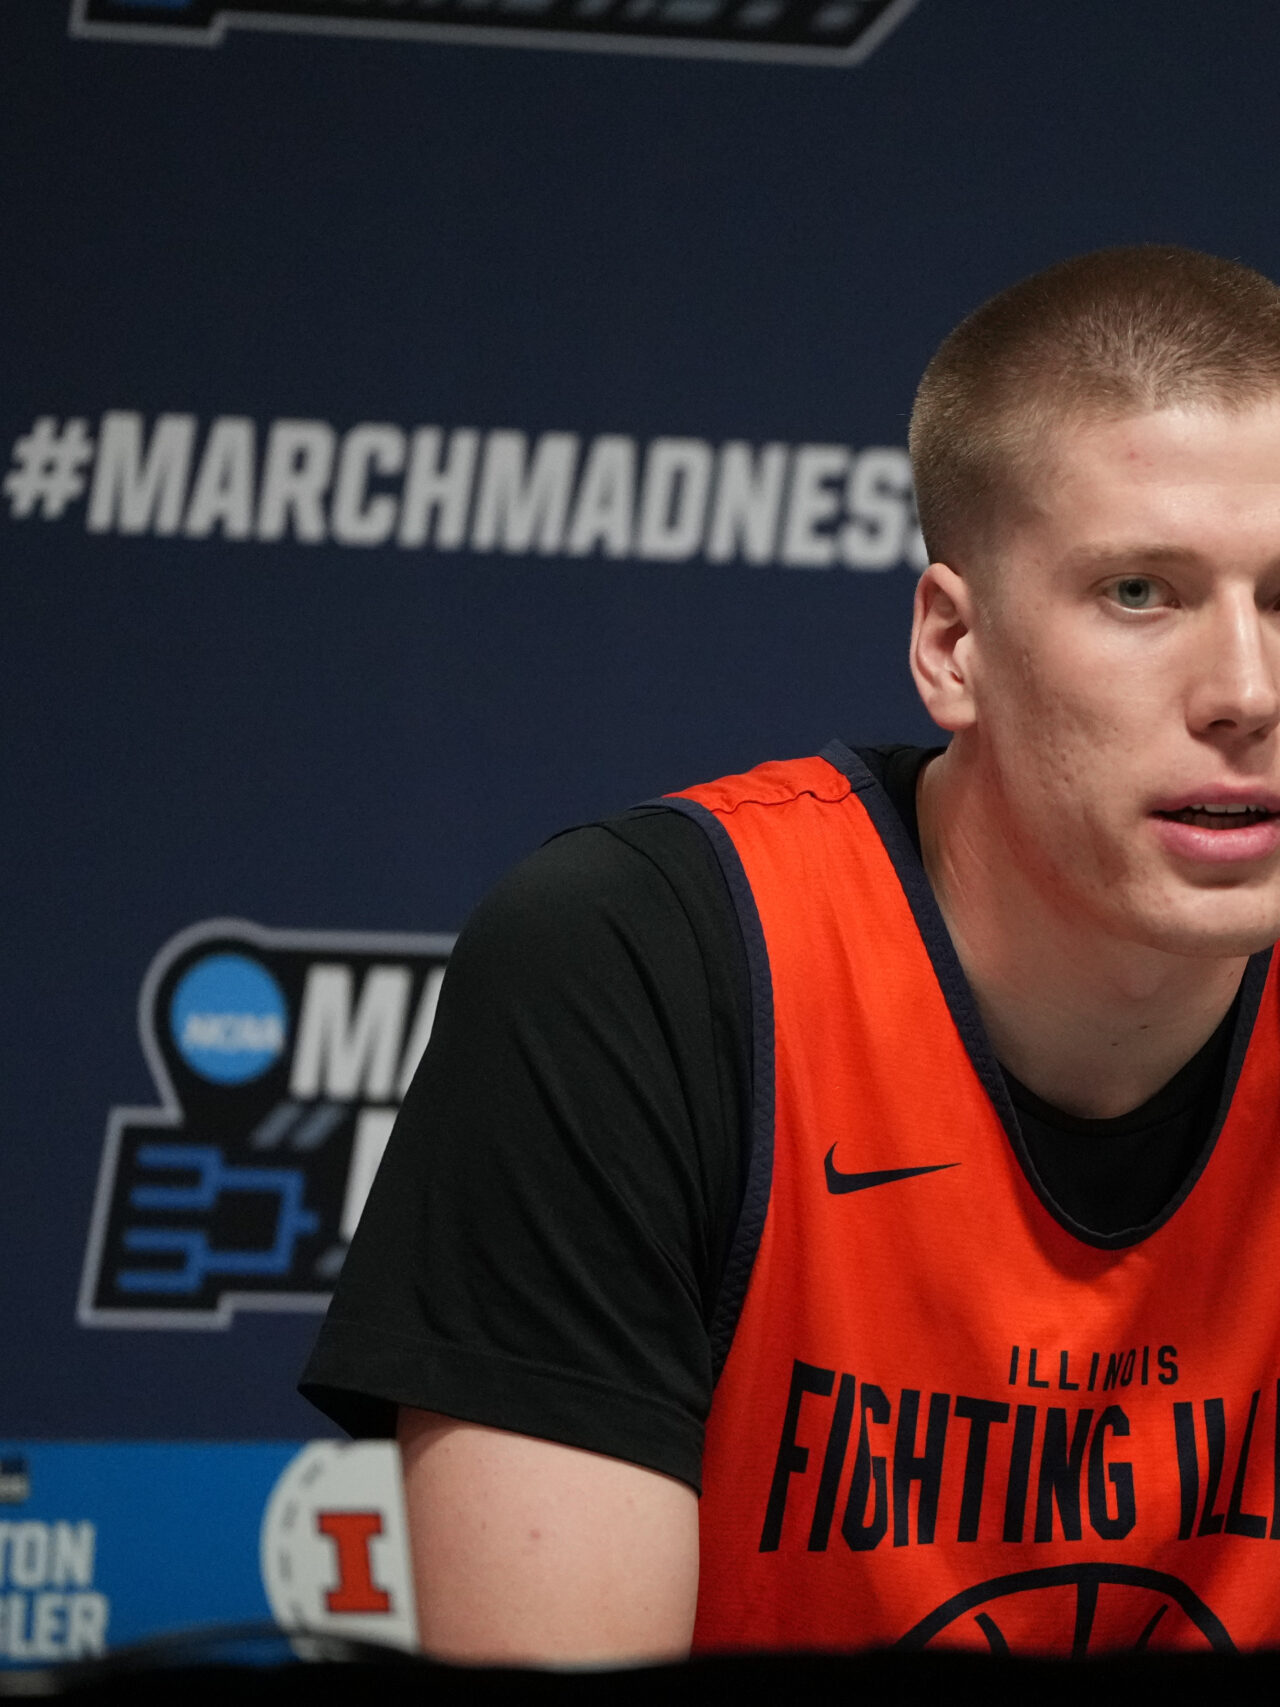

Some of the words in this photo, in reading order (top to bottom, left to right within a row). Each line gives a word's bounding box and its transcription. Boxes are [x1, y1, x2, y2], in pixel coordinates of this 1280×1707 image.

[5, 411, 930, 573] #MARCHMADNES
[1008, 1345, 1179, 1392] ILLINOIS
[759, 1359, 1137, 1553] FIGHTING
